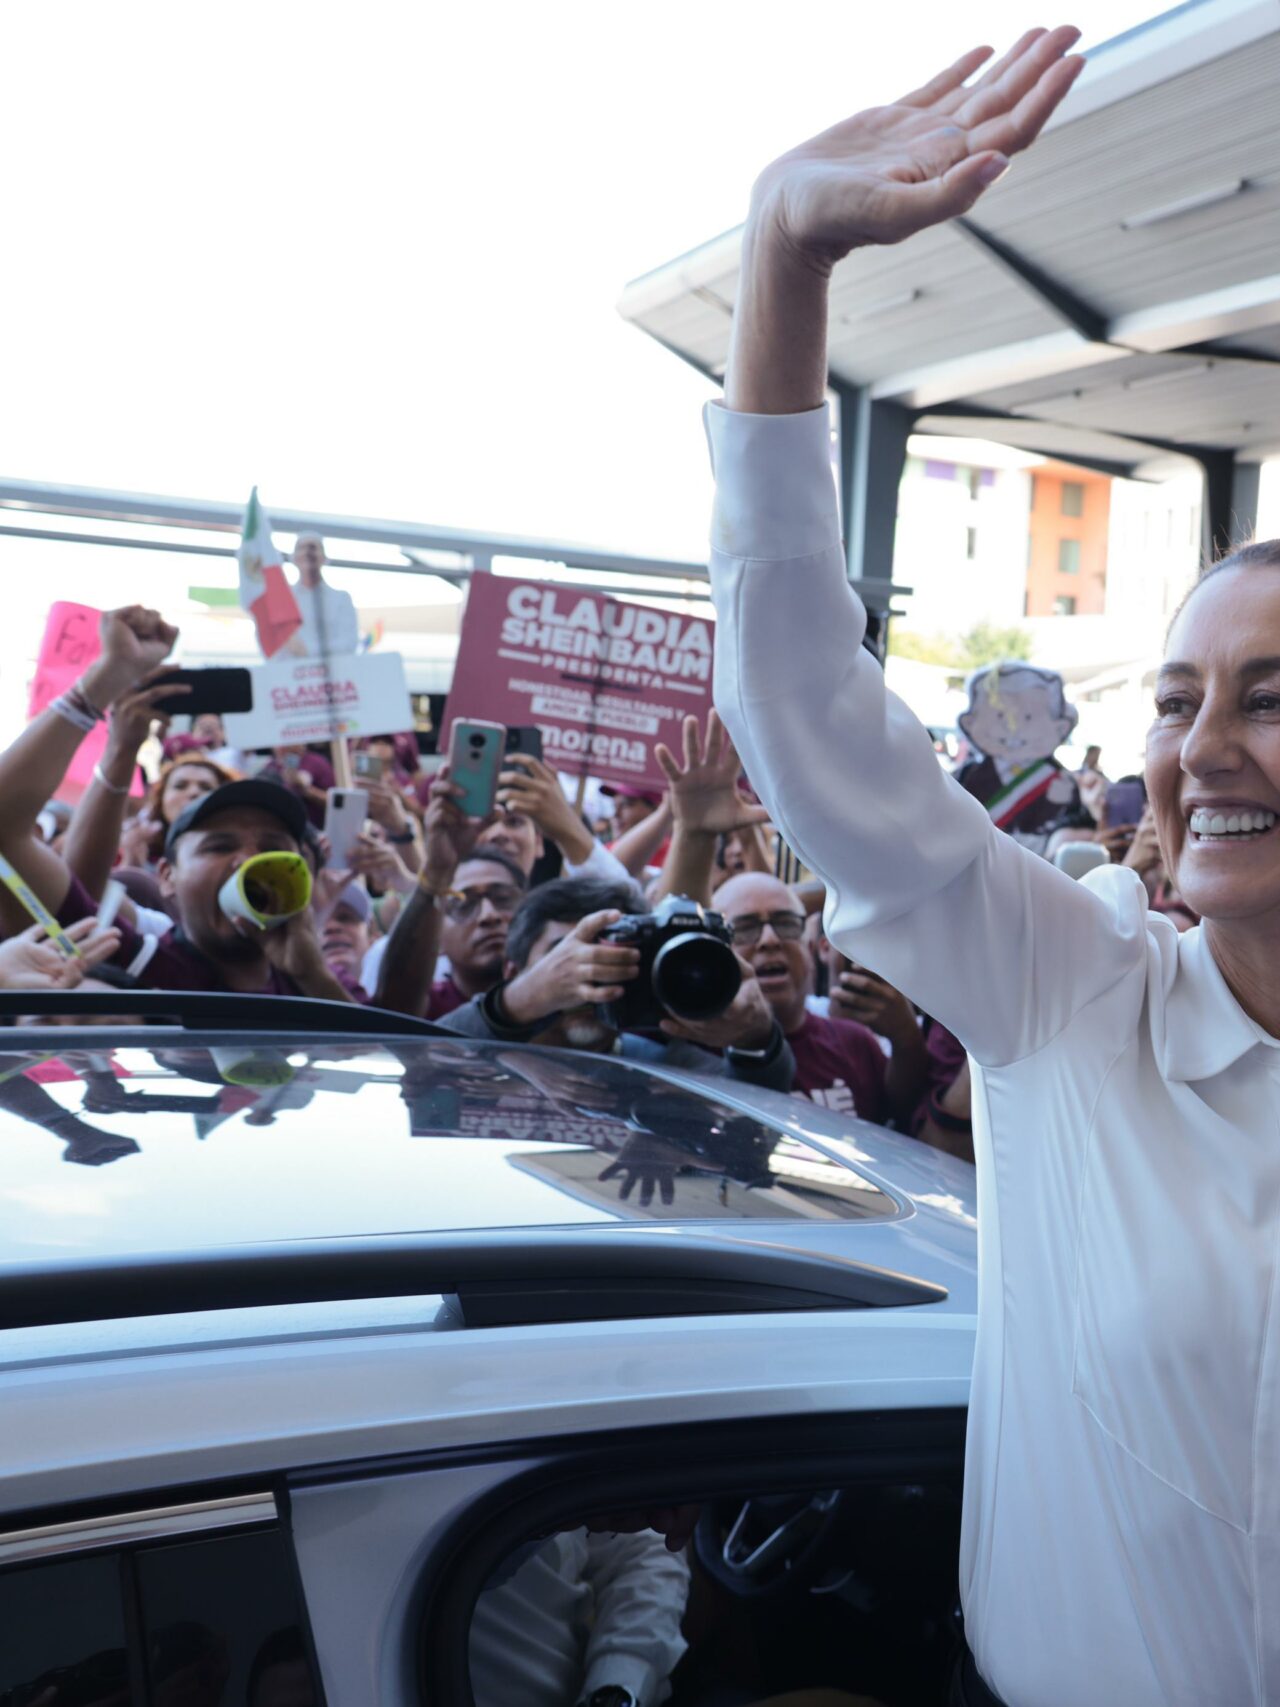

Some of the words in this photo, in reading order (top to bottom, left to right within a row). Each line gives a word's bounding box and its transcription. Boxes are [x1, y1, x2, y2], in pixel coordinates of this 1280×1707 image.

[507, 585, 712, 655] CLAUDIA
[501, 617, 711, 681] SHEINBAUM
[541, 652, 664, 690] PRESIDENTA
[535, 723, 647, 763] morena
[671, 917, 701, 926] Nikon
